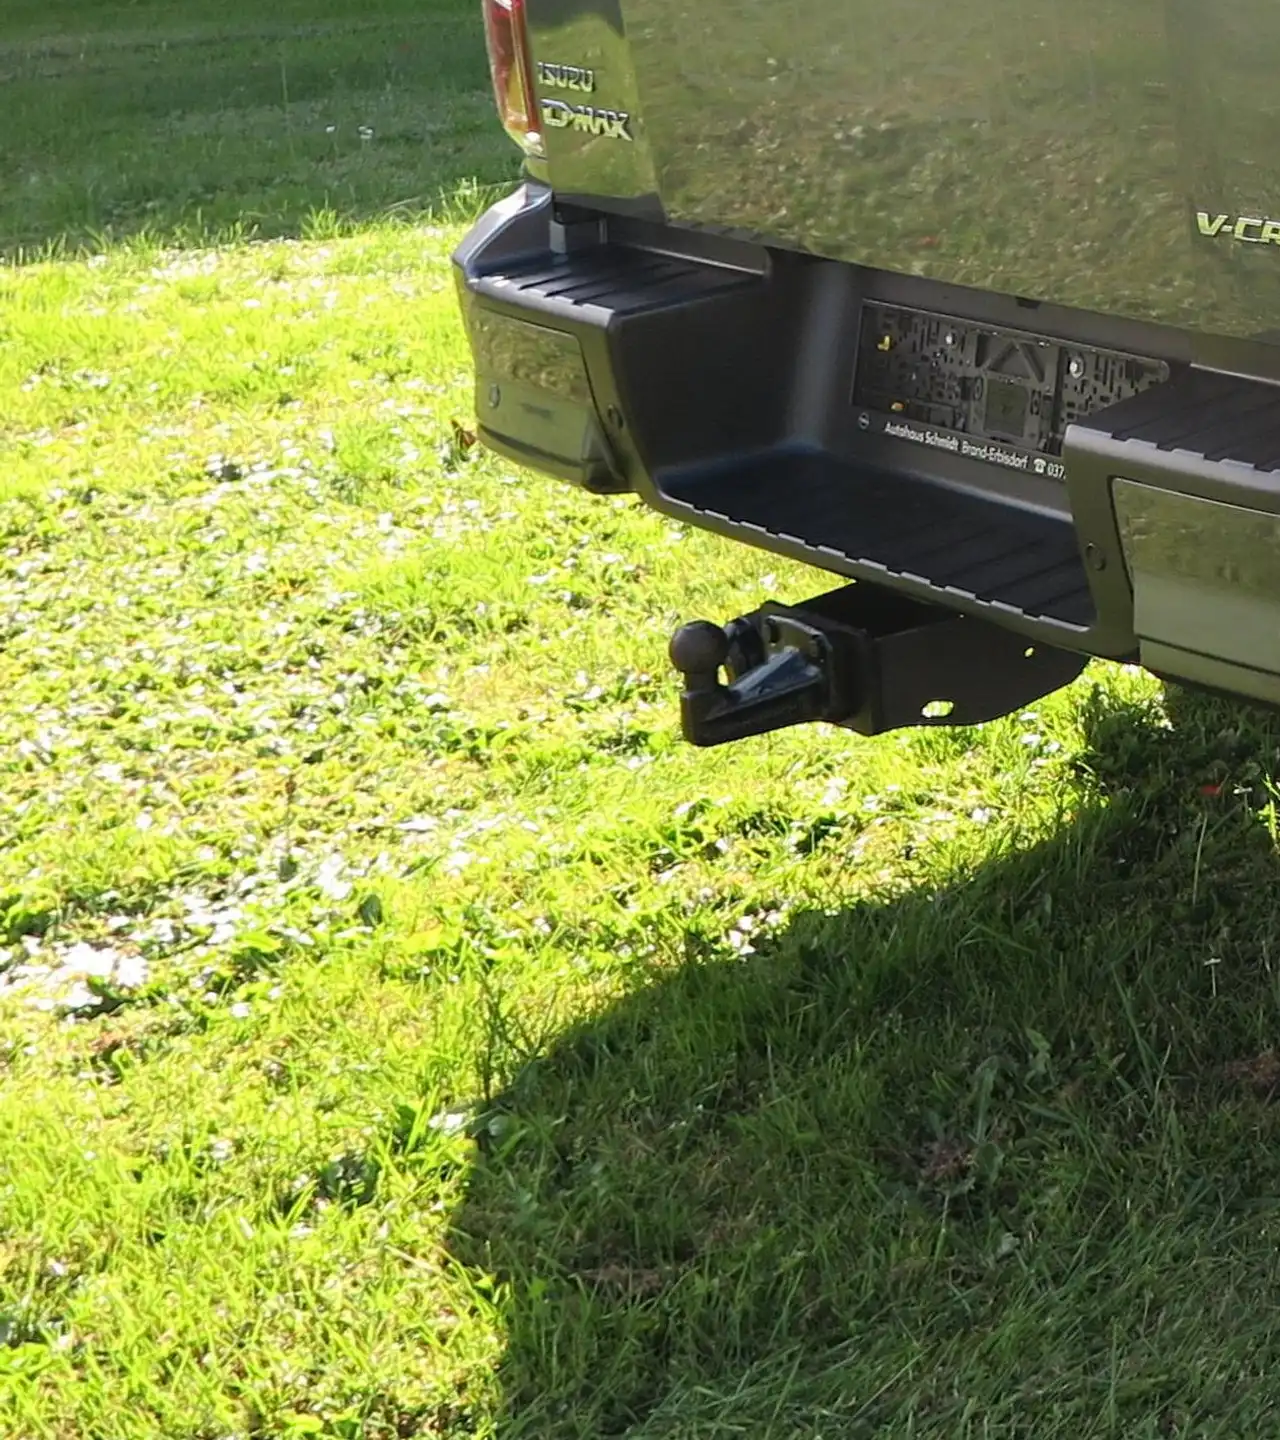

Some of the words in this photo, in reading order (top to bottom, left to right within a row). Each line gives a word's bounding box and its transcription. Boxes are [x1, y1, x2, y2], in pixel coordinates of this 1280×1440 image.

[537, 61, 594, 93] ISUZU
[884, 421, 924, 443] Autohaus
[924, 431, 959, 452] Schmidt
[961, 440, 1029, 470] Brand-Erbisdorf
